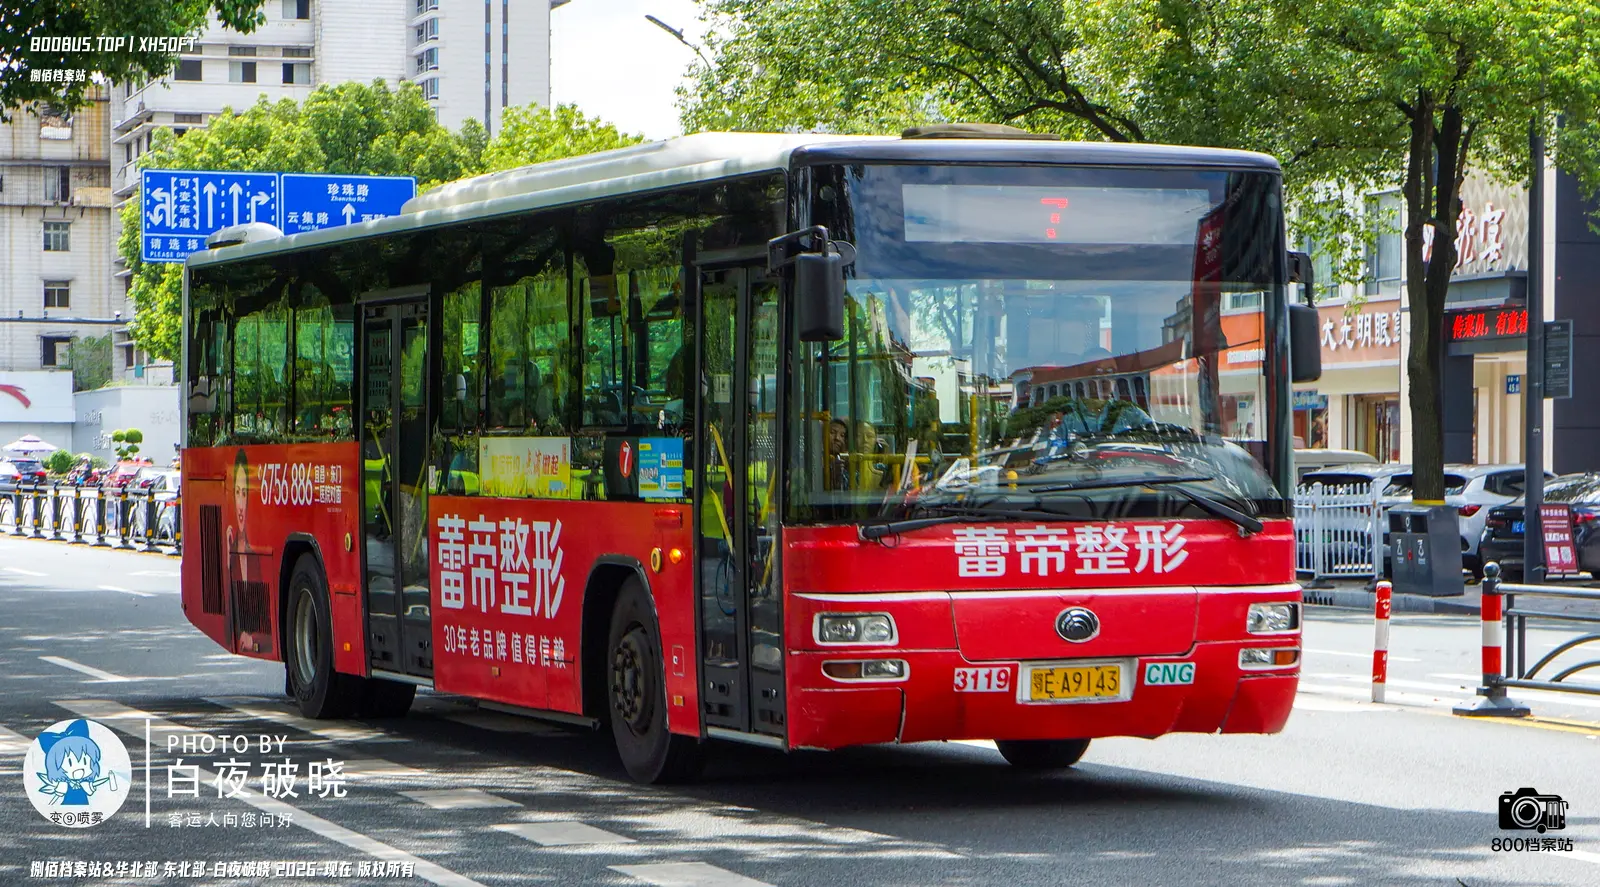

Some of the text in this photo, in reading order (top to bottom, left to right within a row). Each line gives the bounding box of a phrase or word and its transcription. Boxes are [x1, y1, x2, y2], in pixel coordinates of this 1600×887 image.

[327, 183, 369, 196] 珍珠路
[179, 178, 191, 229] 可变车道
[287, 211, 329, 224] 云集路
[150, 238, 209, 250] 请选择
[623, 446, 631, 474] 7
[260, 462, 313, 505] 6756 886
[953, 523, 1190, 577] 蕾帝整形
[437, 513, 566, 620] 蕾帝整形
[953, 668, 1010, 691] 3119
[1146, 663, 1194, 684] CNG
